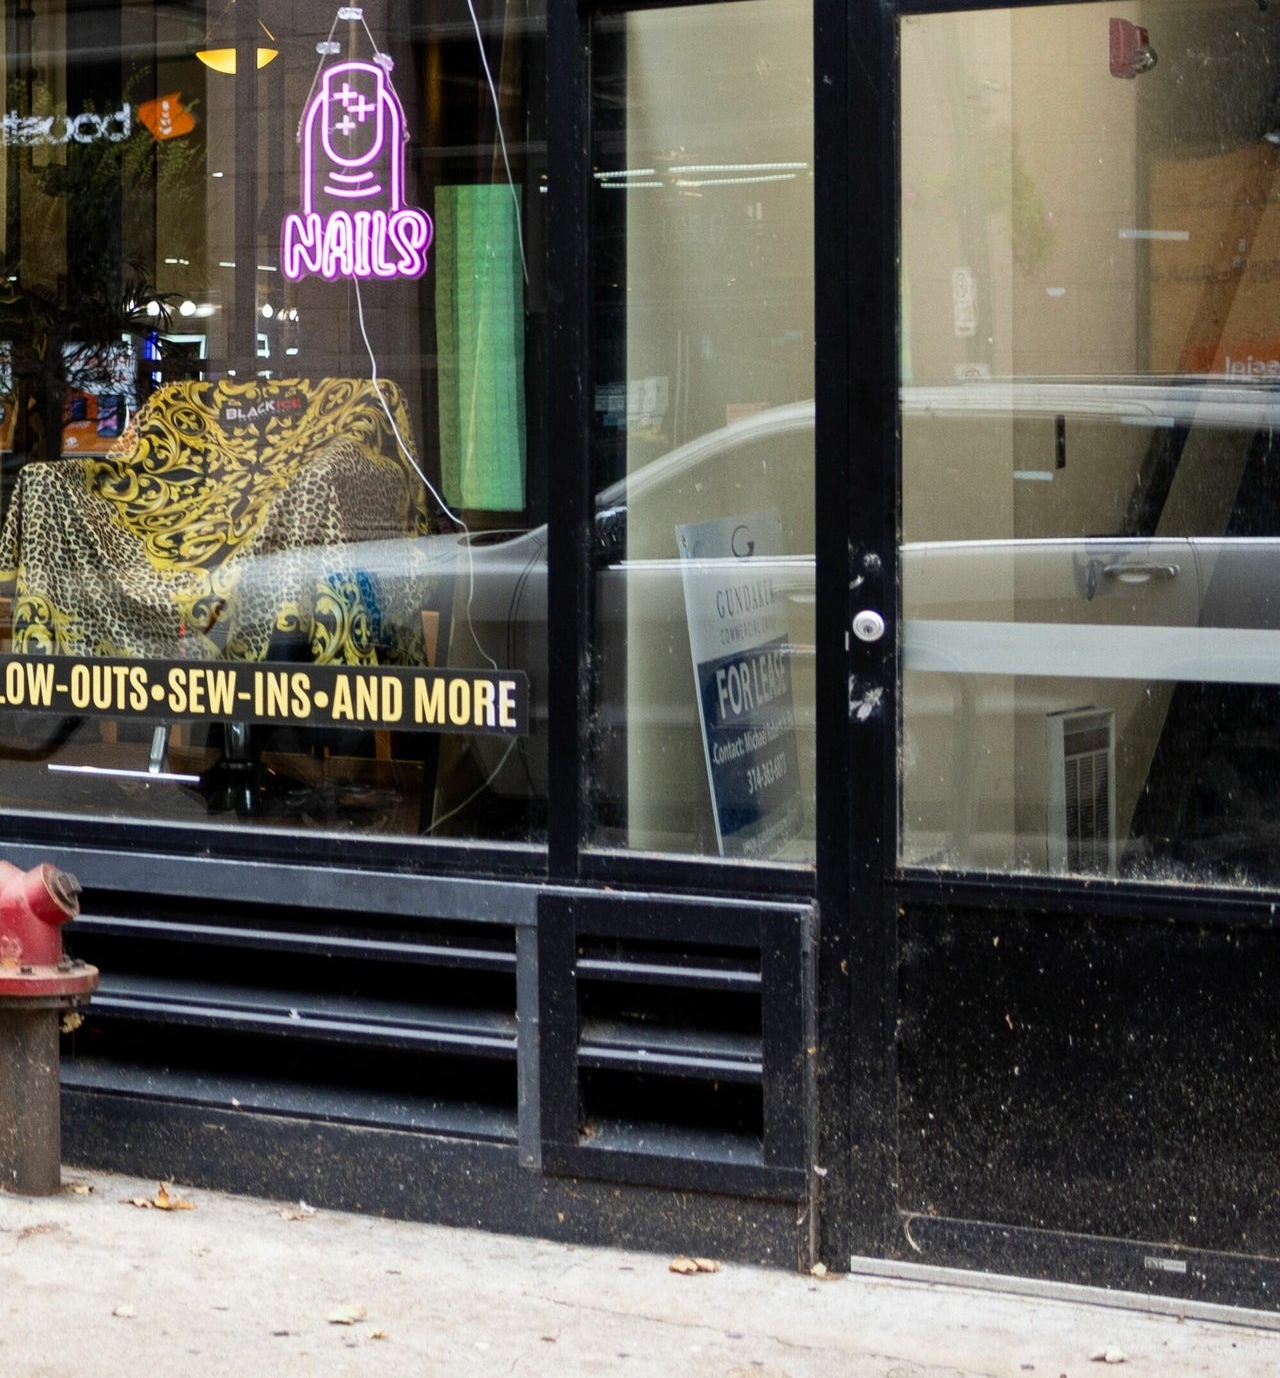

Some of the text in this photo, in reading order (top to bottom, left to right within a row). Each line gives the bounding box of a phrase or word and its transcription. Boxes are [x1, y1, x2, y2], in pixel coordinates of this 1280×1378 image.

[282, 205, 434, 281] NAILS
[225, 399, 276, 421] BLACK
[276, 397, 302, 409] ICE
[332, 674, 403, 723] AND
[415, 678, 517, 729] MORE
[715, 651, 788, 720] FOR LEASE
